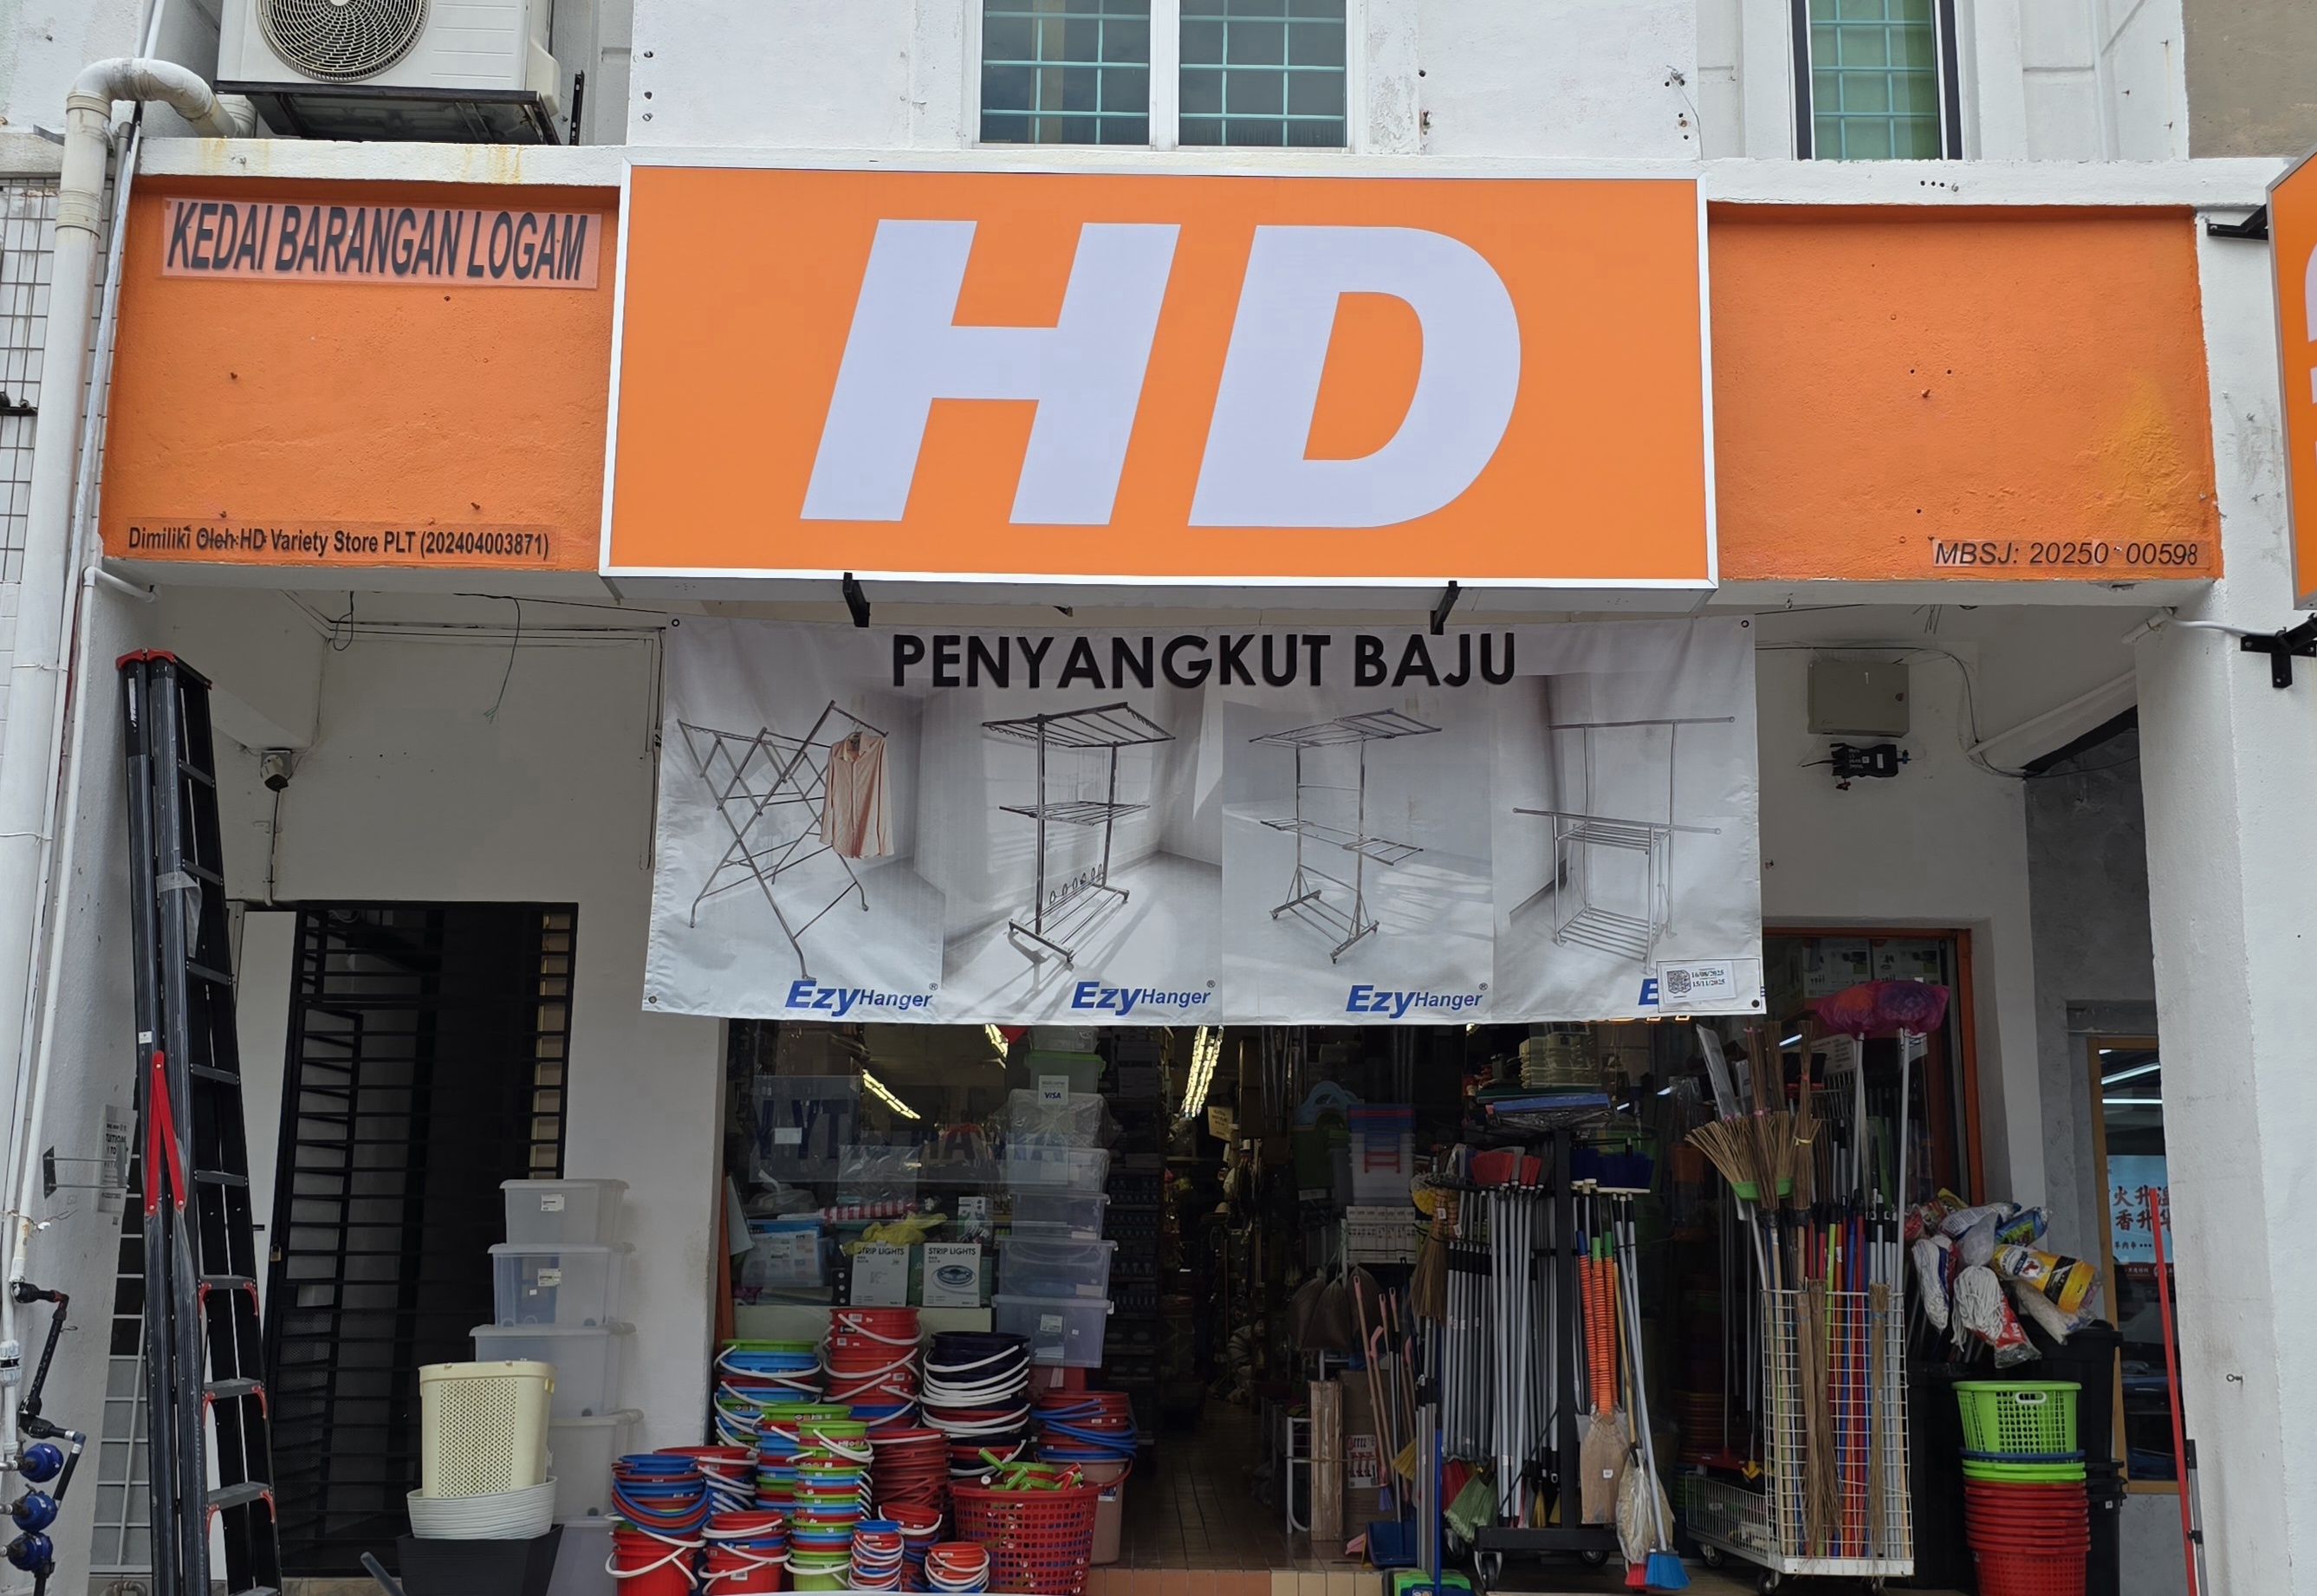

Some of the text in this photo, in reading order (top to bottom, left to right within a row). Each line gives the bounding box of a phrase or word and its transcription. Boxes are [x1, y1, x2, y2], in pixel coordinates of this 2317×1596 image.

[167, 202, 588, 281] KEDAI BARANGAN LOGAM
[800, 218, 1521, 528] HD
[129, 527, 191, 549] Dimiliki
[240, 528, 265, 551] HD
[271, 529, 328, 556] Variety
[333, 529, 378, 554] Store
[383, 530, 417, 554] PLT
[420, 530, 549, 560] (202404003871)
[1935, 542, 2019, 565] MBSJ:
[892, 633, 1515, 689] PENYANGKUT BAJU
